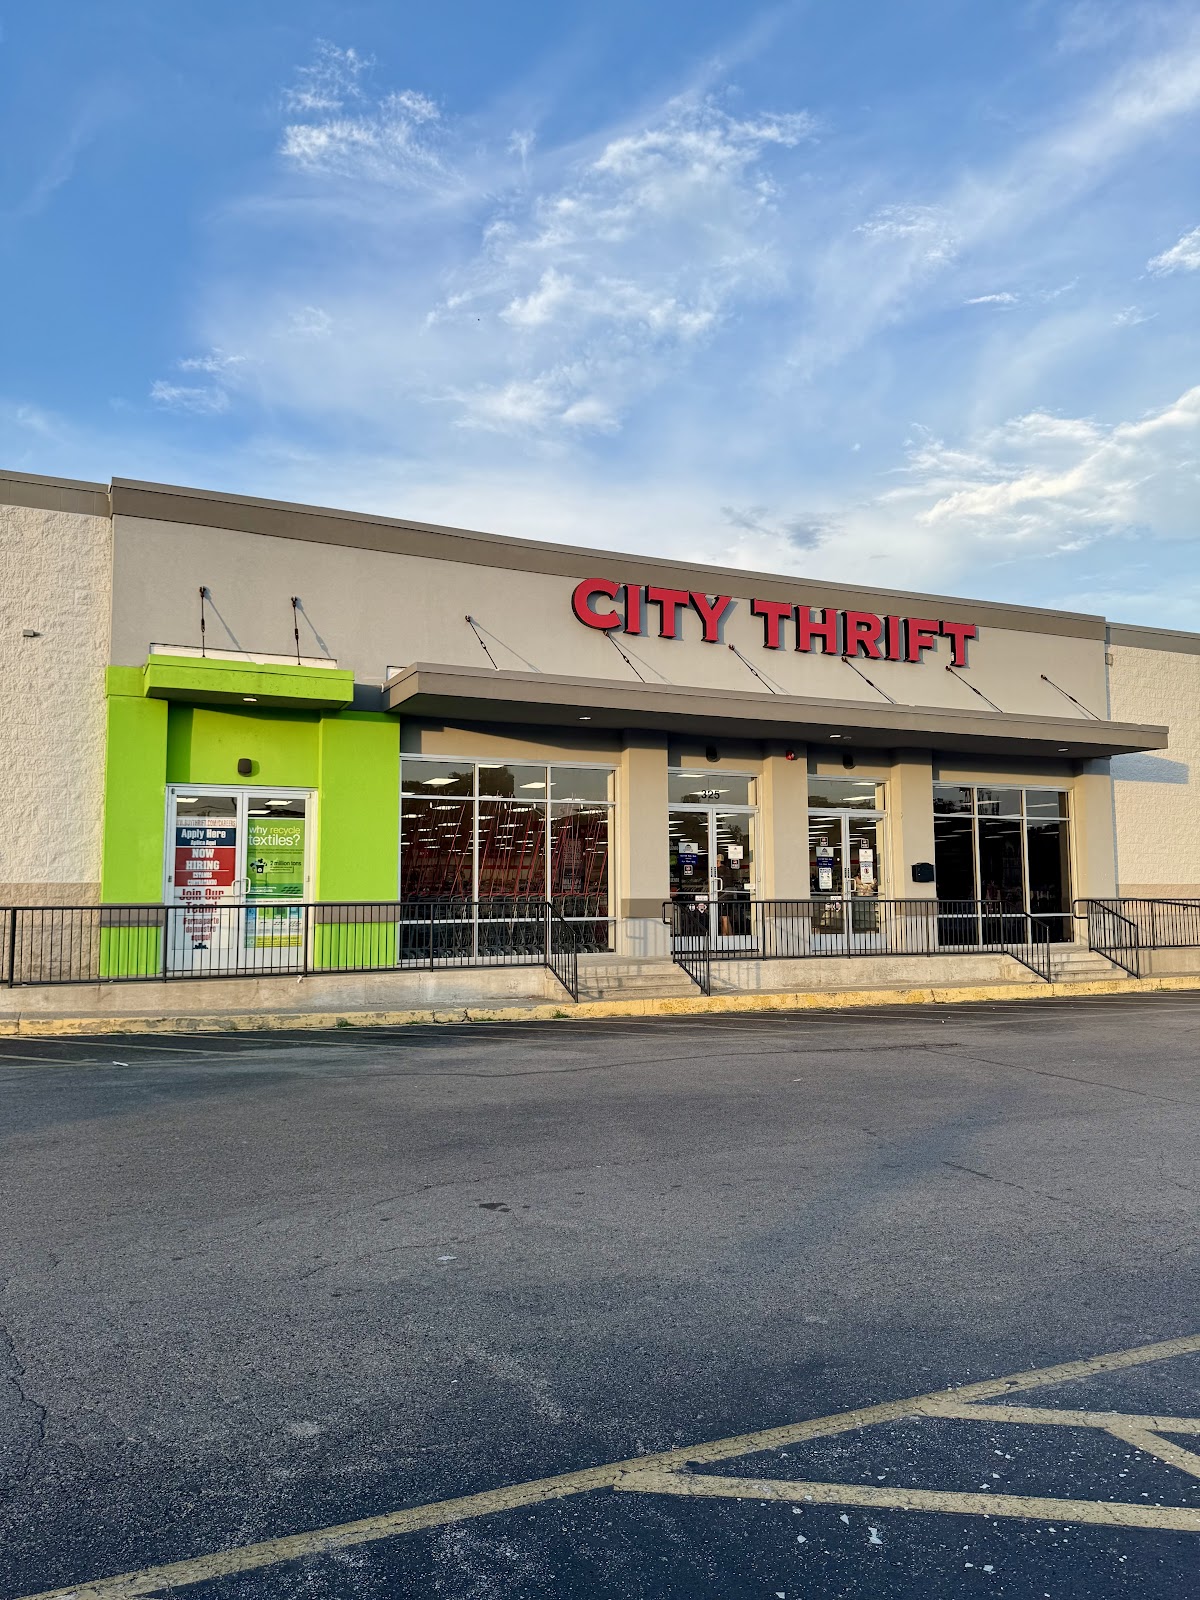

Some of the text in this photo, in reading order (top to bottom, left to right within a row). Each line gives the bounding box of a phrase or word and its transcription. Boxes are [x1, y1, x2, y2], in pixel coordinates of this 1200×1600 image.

[572, 577, 977, 666] CITY THRIFT
[701, 790, 720, 799] 325
[181, 829, 226, 839] Apply Here
[249, 825, 301, 836] why recycle
[248, 834, 301, 846] textiles?
[192, 848, 215, 858] NOW
[185, 860, 220, 870] HIRING
[179, 888, 224, 900] Join Our
[186, 901, 217, 913] Team!
